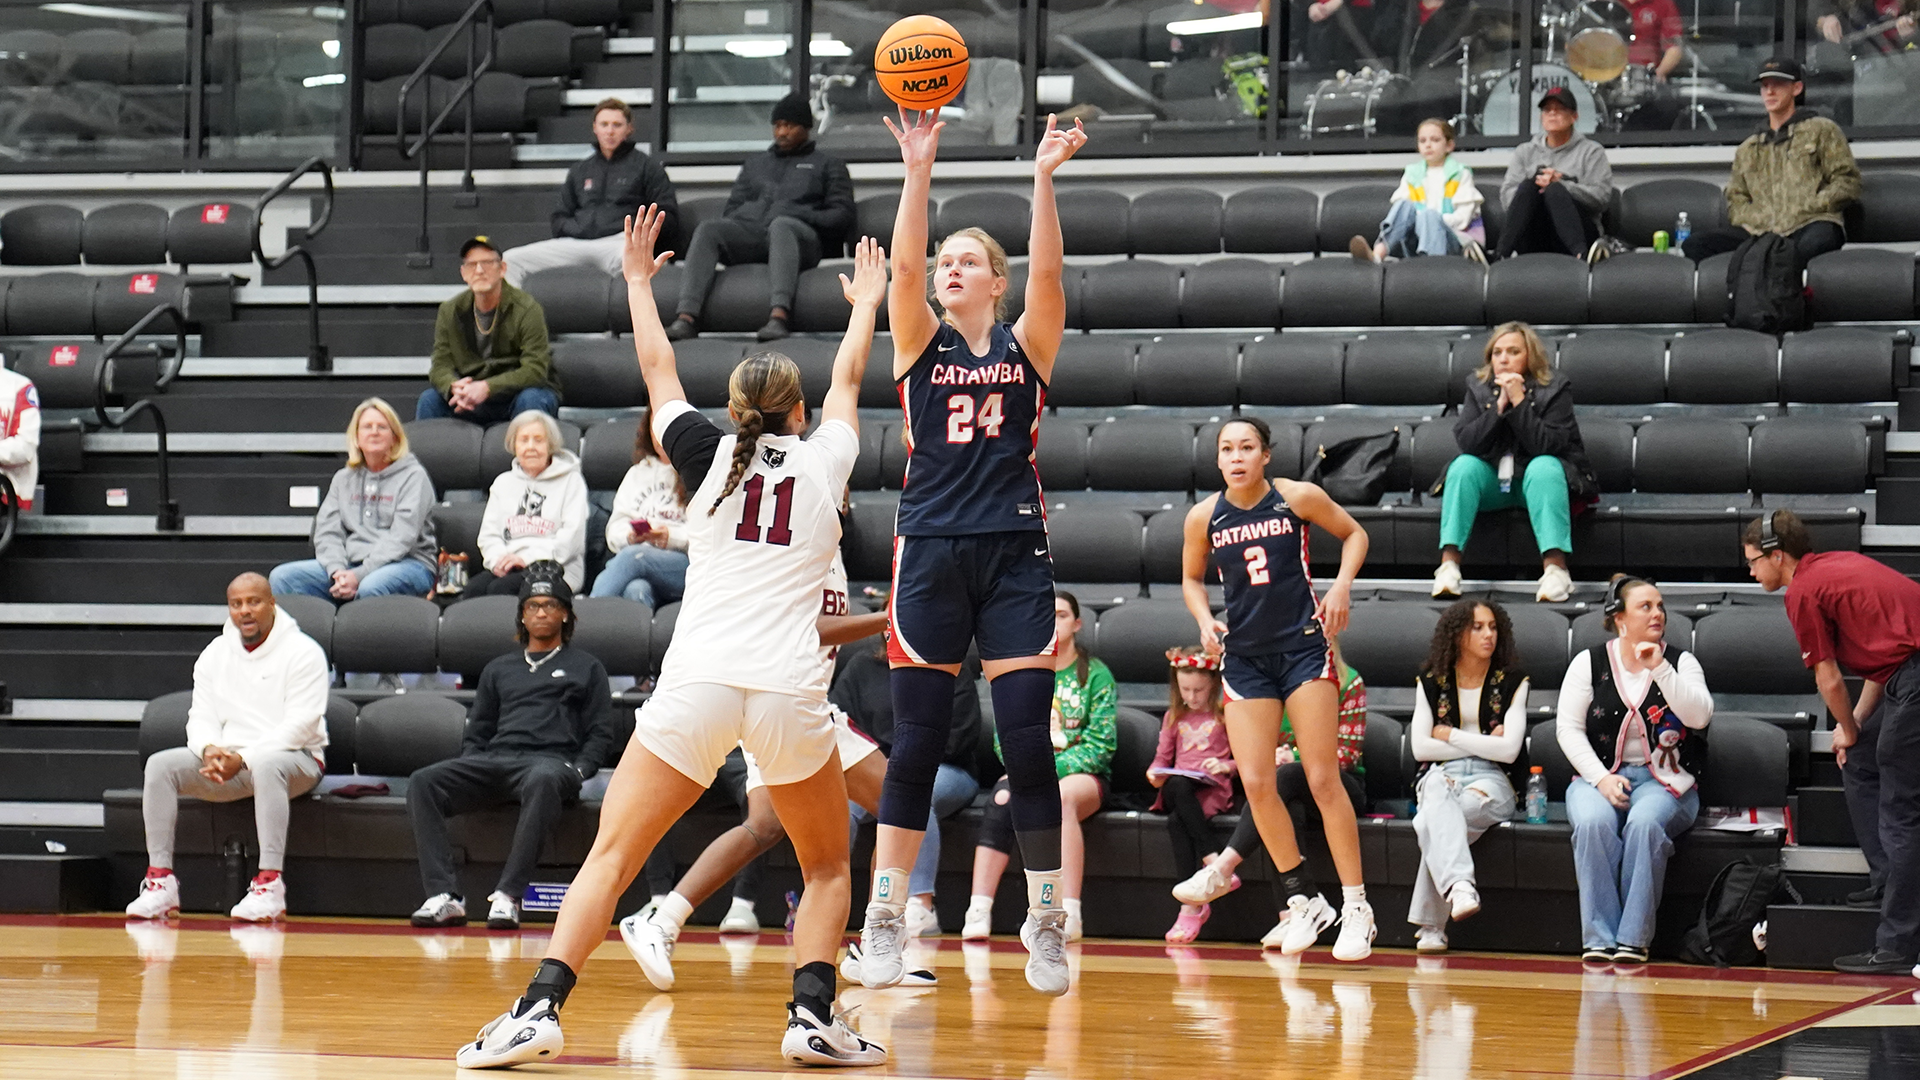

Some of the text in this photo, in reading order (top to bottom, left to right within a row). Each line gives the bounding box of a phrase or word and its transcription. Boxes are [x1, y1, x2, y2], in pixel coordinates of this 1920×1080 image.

[889, 44, 953, 65] Wilson
[902, 74, 949, 92] NCAA
[930, 362, 1026, 385] CATAWBA
[946, 392, 1006, 444] 24
[735, 472, 796, 546] 11
[1211, 517, 1294, 549] CATAWBA
[1243, 545, 1271, 586] 2
[823, 589, 850, 616] BE
